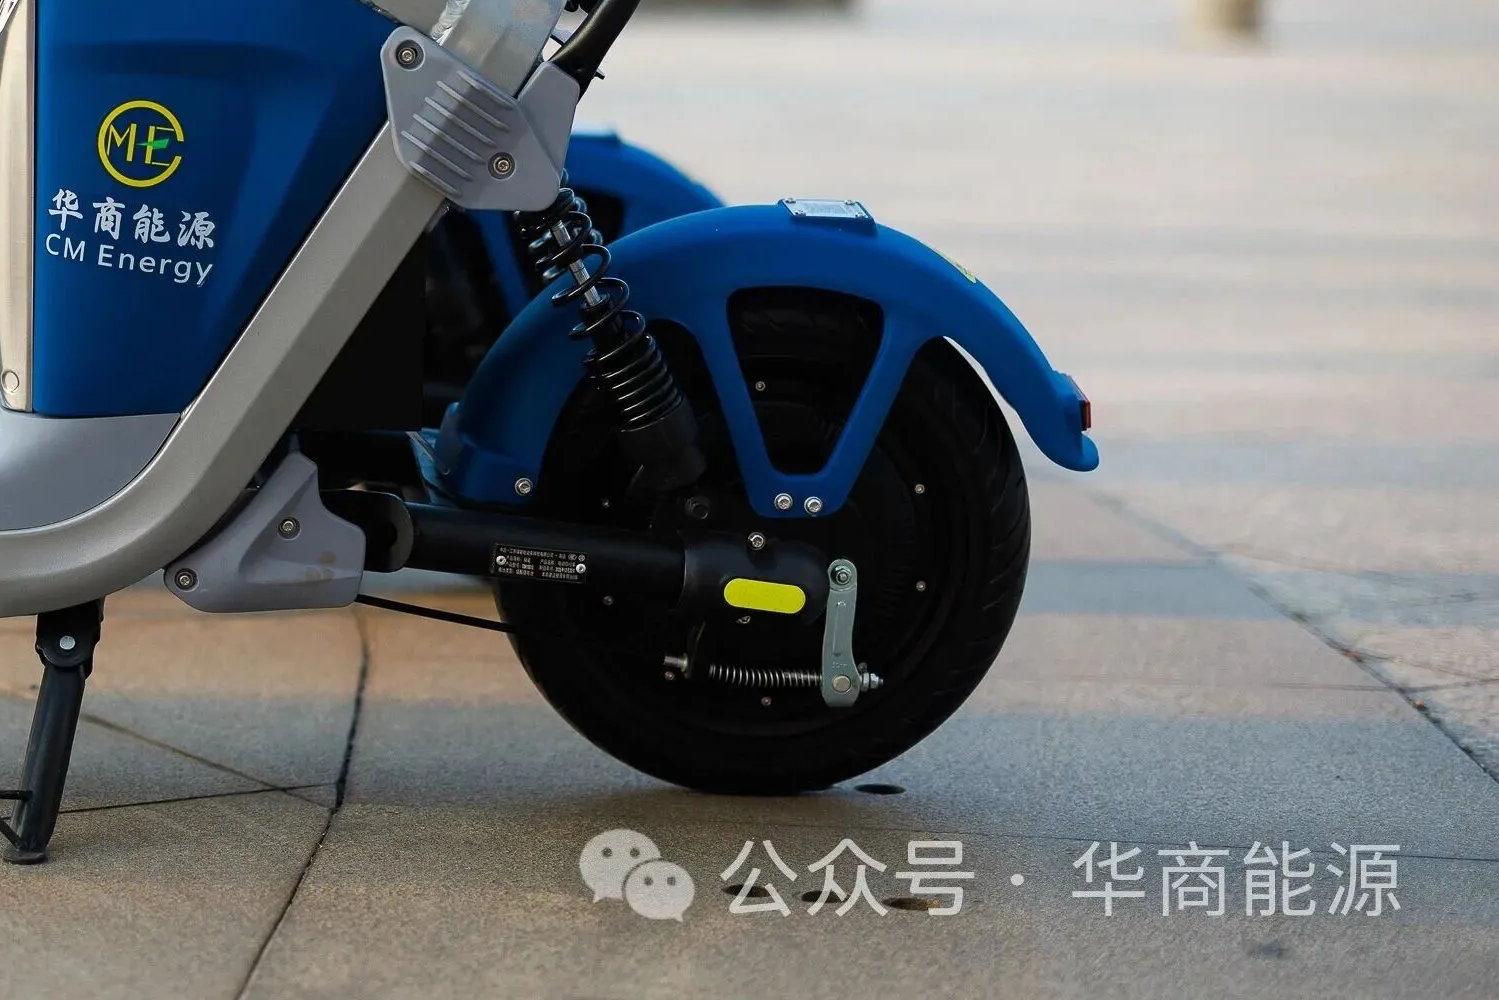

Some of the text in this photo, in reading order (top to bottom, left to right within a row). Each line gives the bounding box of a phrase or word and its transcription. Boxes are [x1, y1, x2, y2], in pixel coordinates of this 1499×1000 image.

[48, 188, 216, 250] 华商能源
[45, 233, 213, 287] CM Energy
